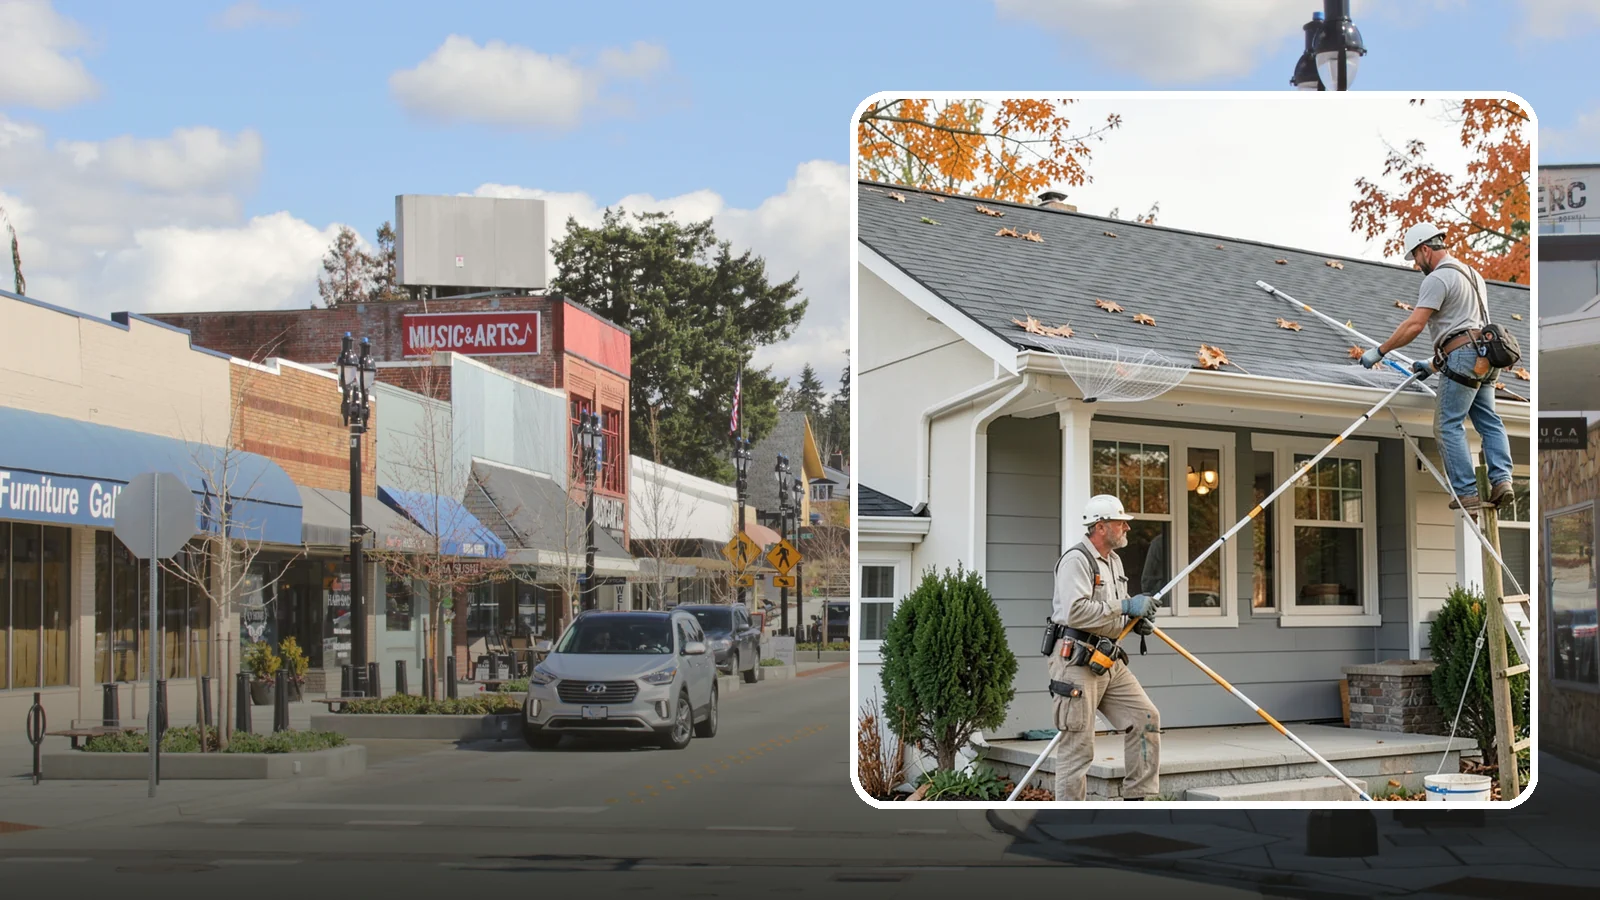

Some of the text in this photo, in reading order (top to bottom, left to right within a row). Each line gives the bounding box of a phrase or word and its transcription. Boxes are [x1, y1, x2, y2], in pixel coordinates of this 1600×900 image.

[409, 323, 519, 349] MUSIC&ARTS
[1541, 428, 1577, 436] UGA
[0, 472, 121, 519] Furniture Gal
[453, 563, 479, 574] SUSHI
